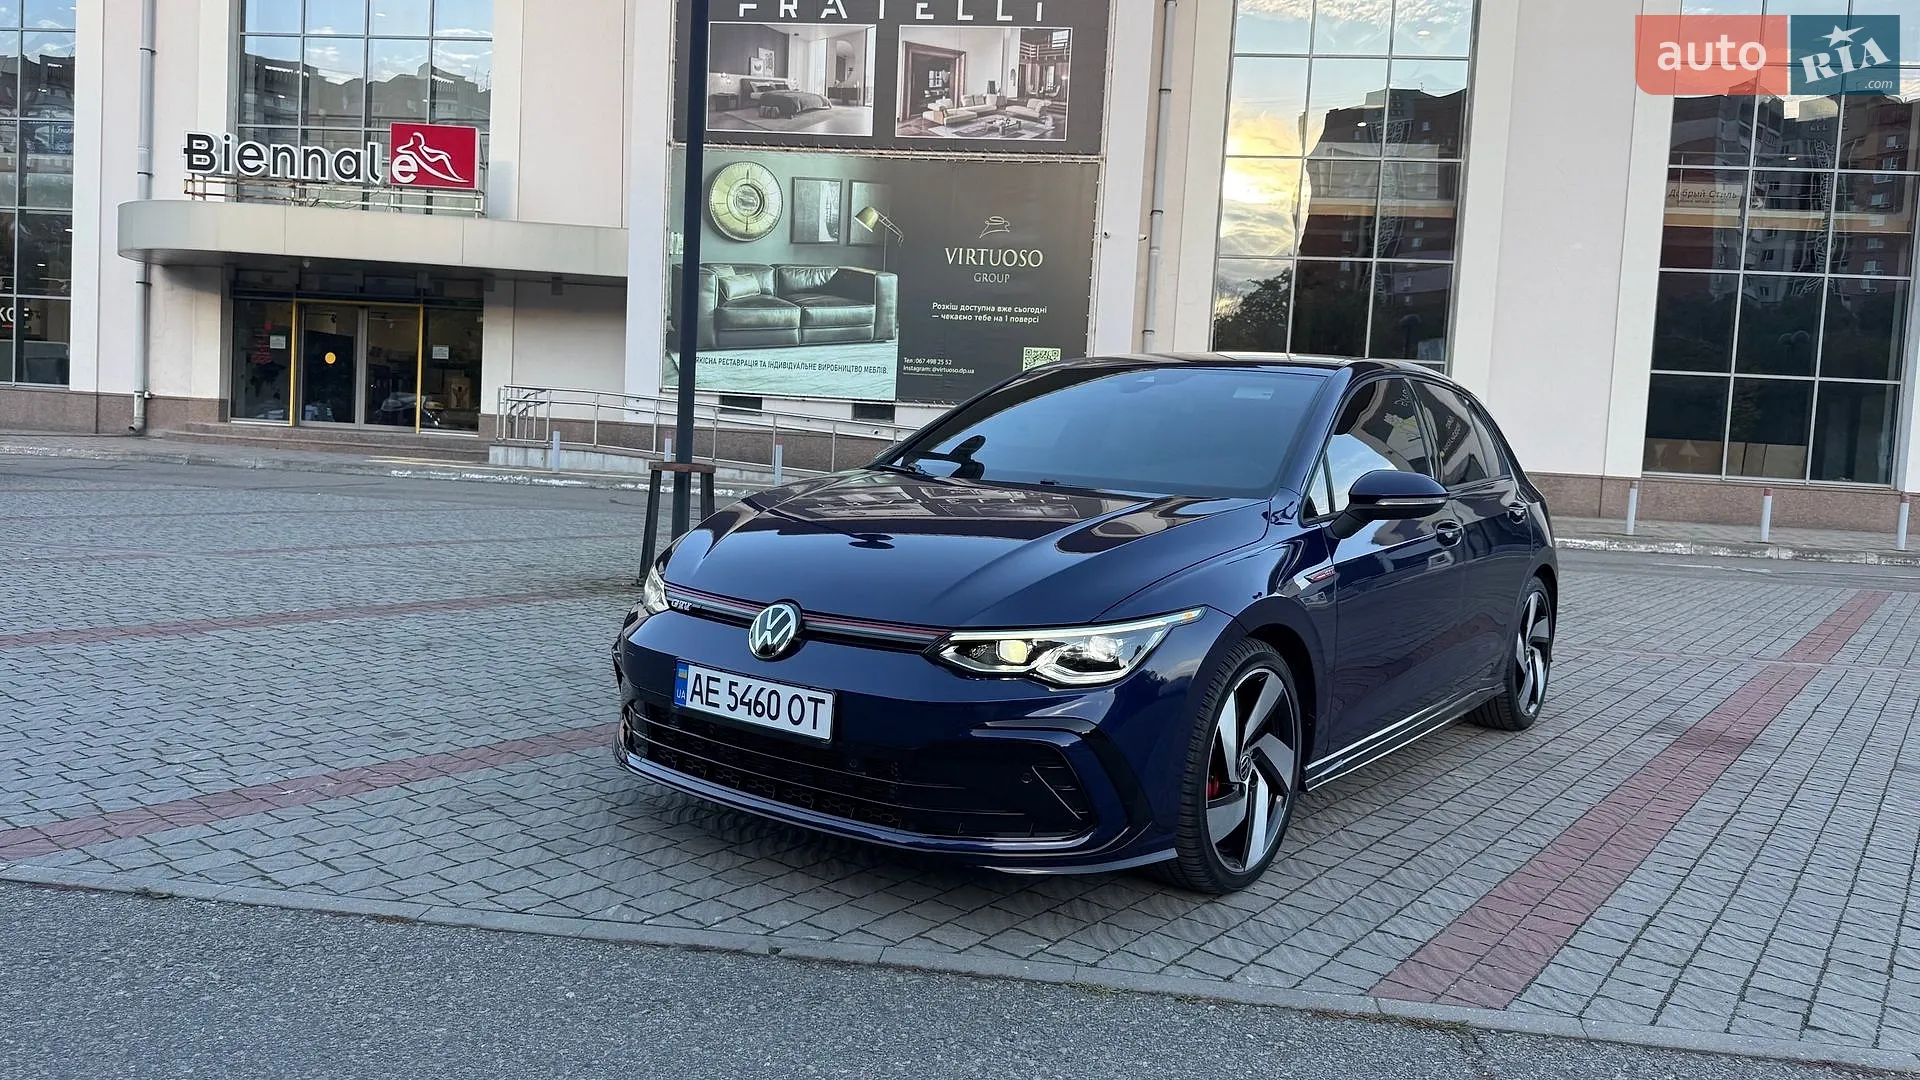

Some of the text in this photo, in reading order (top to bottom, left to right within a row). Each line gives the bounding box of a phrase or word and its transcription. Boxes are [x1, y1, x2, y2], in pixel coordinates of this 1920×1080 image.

[184, 130, 420, 184] Biennale
[944, 247, 1044, 268] VIRTUOSO
[973, 272, 1010, 283] GROUP
[932, 302, 958, 311] Розкіш
[959, 304, 995, 313] доступна
[1013, 305, 1047, 314] сьогодні
[940, 313, 973, 321] чекаємо
[975, 314, 992, 322] тебе
[1009, 315, 1039, 324] поверсі
[717, 358, 759, 368] РЕСТАВРАЦІЯ
[759, 360, 767, 368] ТА
[767, 360, 817, 372] ІНДИВІДУАЛЬНЕ
[818, 363, 863, 374] ВИРОБНИЦТВО
[676, 688, 687, 700] UA
[689, 673, 826, 730] AE 5460 OT
